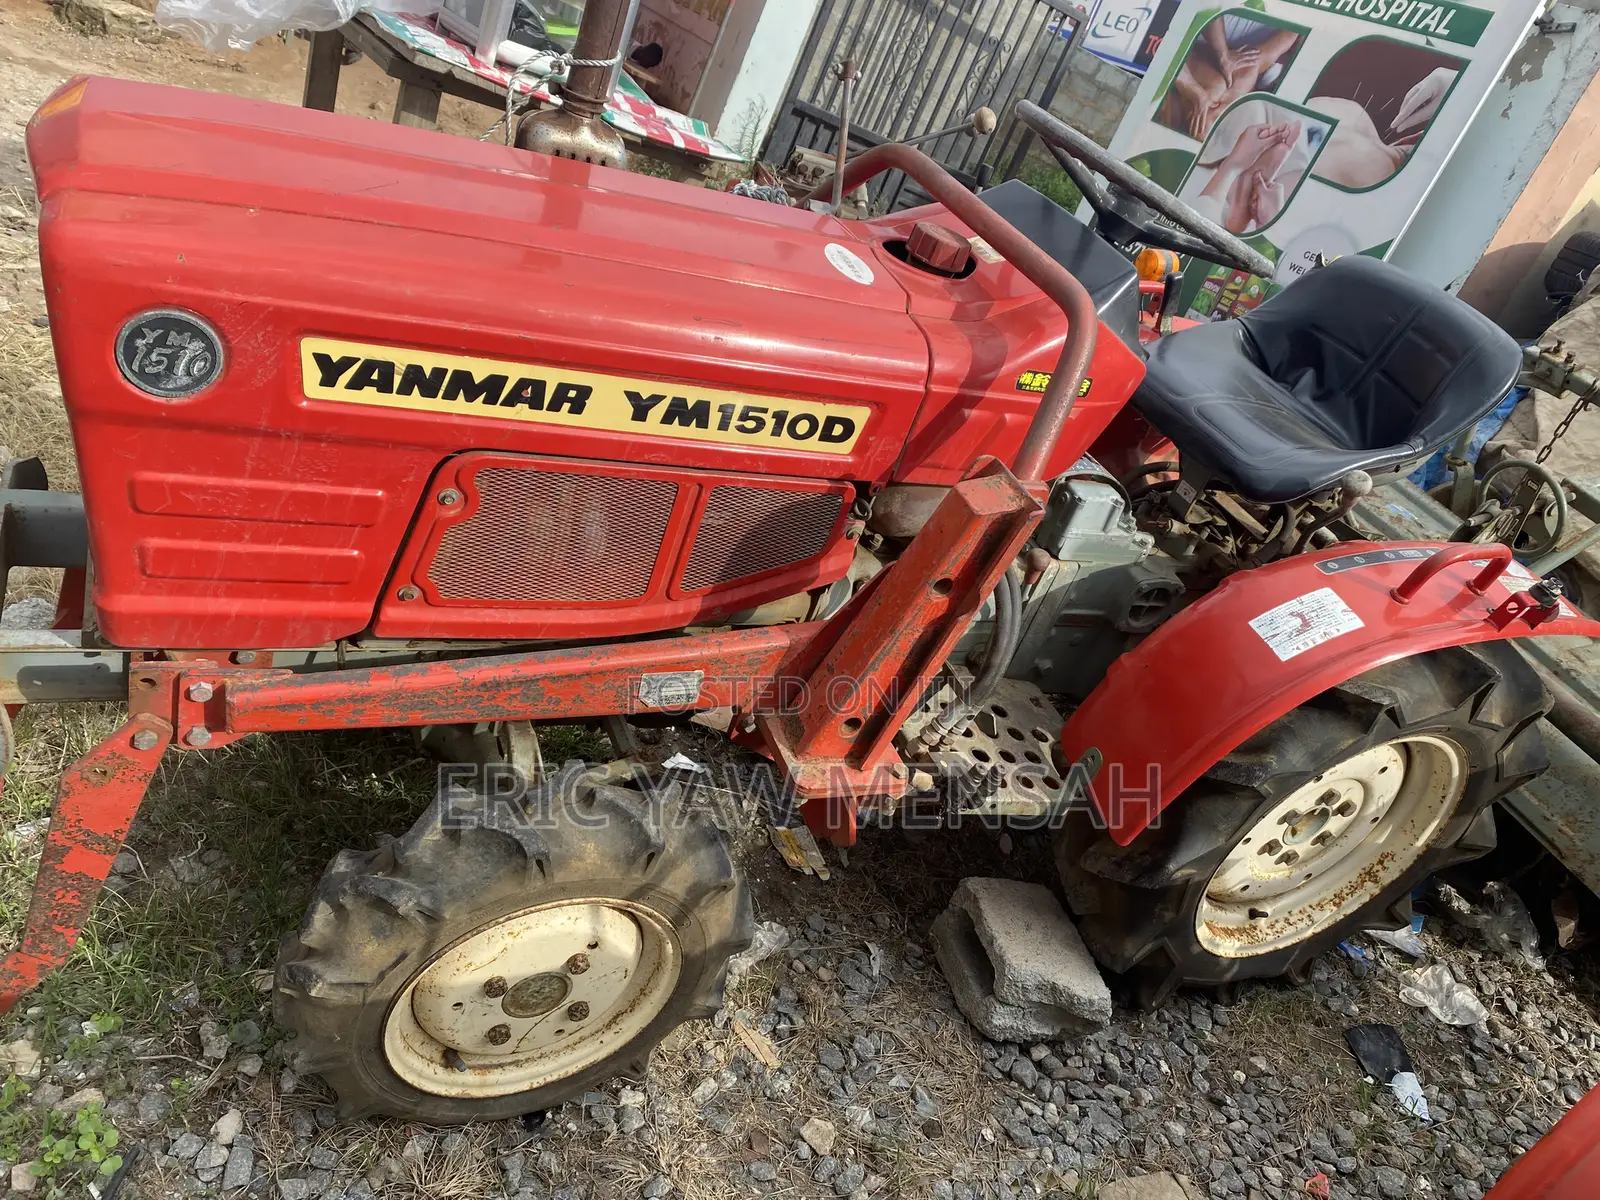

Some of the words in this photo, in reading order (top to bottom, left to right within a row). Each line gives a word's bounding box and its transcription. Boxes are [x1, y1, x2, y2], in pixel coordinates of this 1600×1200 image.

[1103, 11, 1140, 34] LEO
[311, 352, 593, 415] YANMAR
[623, 390, 856, 443] YM1510D
